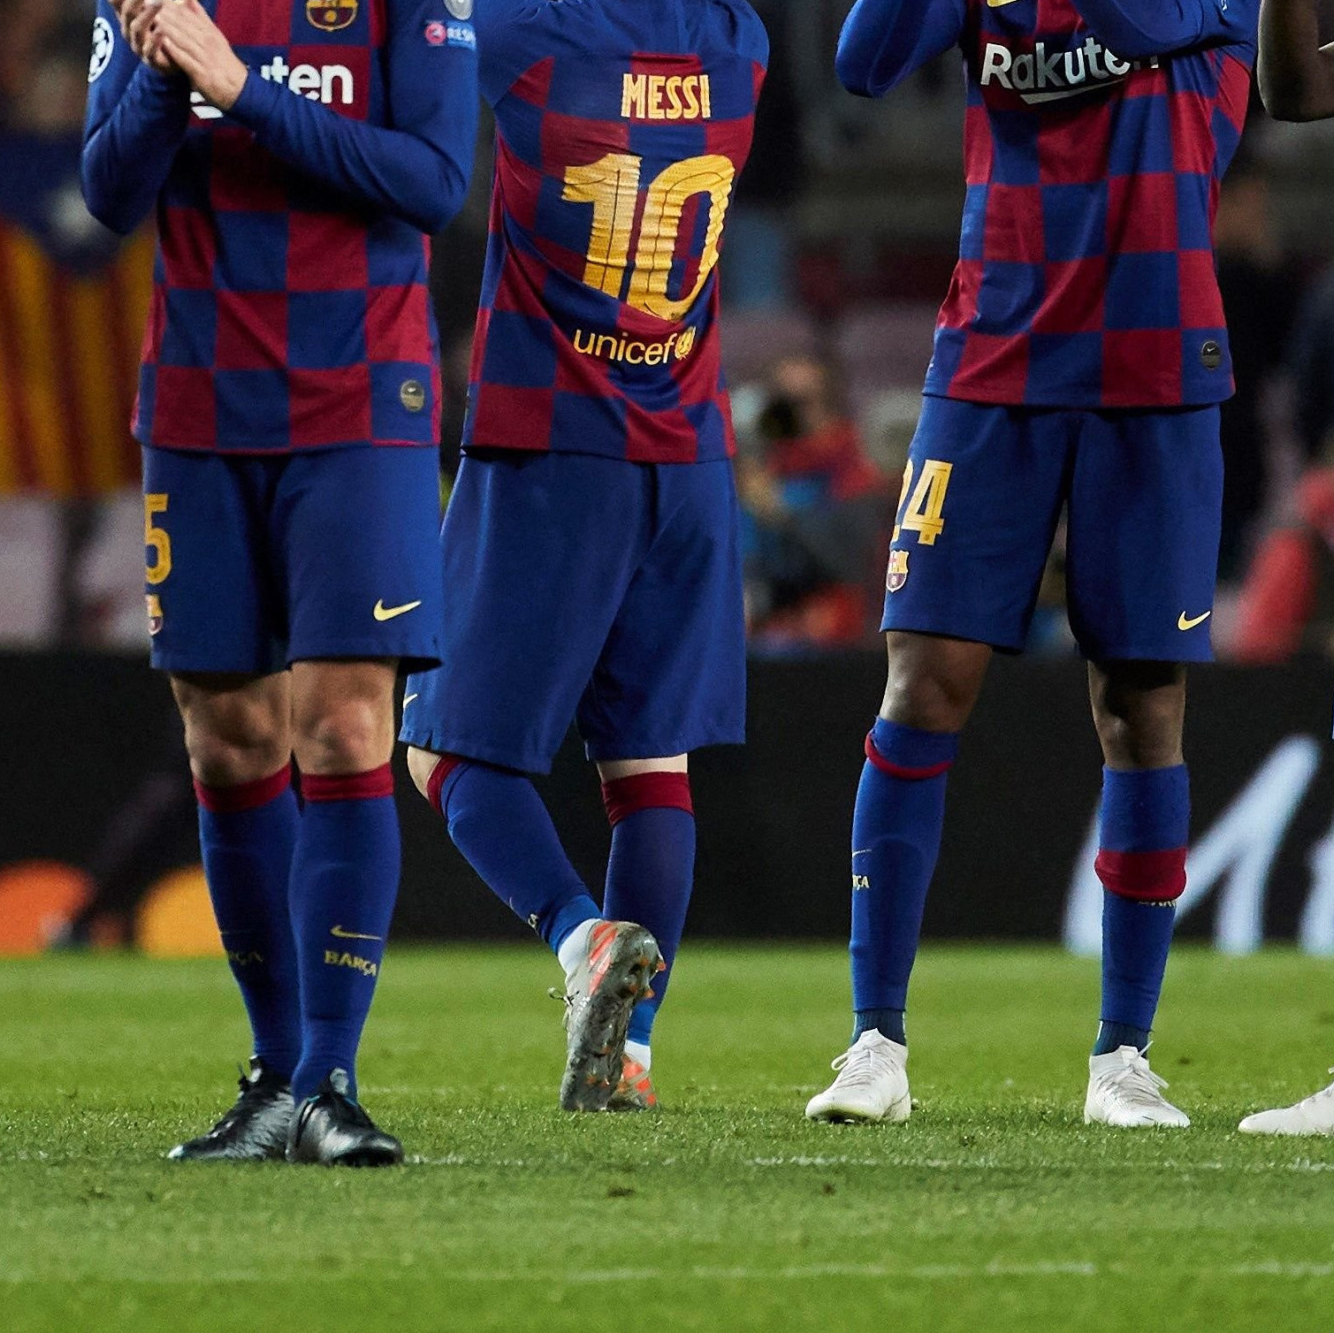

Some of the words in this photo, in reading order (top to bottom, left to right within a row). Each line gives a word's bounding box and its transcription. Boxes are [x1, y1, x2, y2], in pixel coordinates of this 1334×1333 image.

[620, 73, 711, 119] MESSI
[561, 153, 735, 322] 10
[573, 328, 679, 366] unicef
[324, 949, 377, 977] BARÇA
